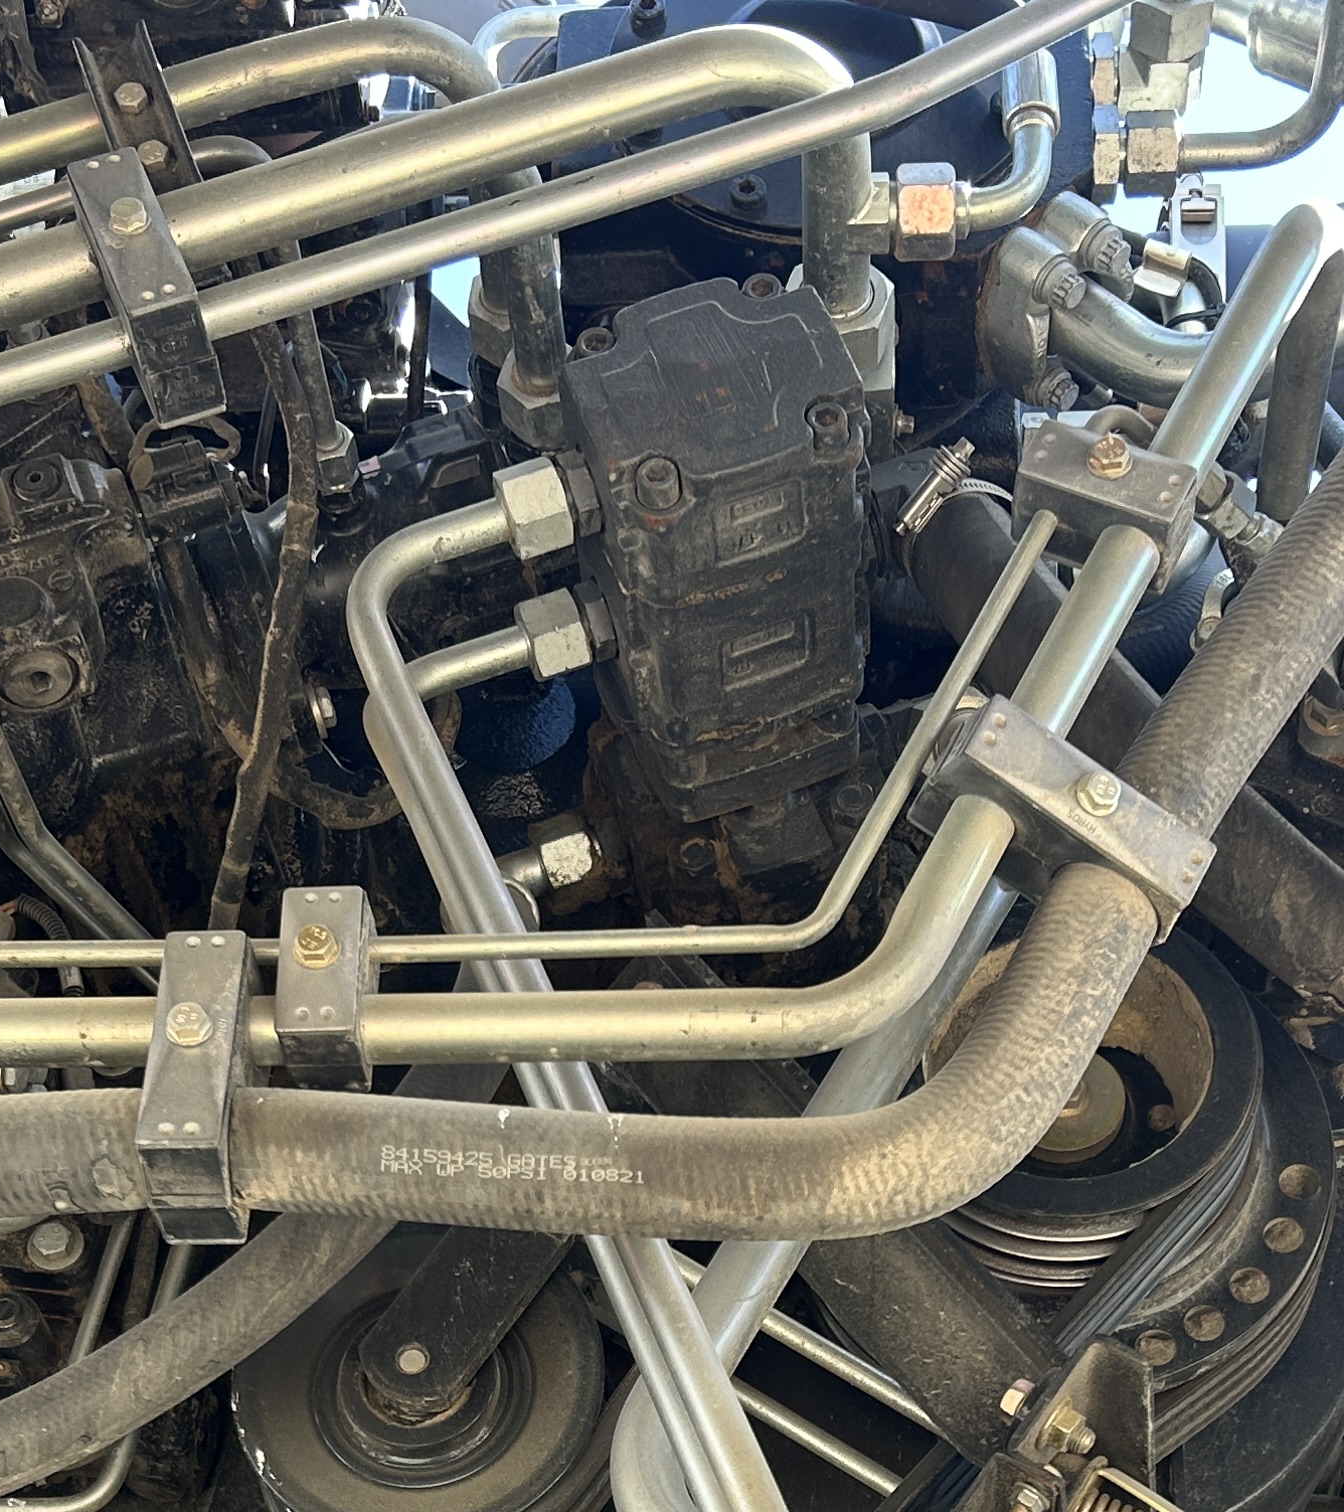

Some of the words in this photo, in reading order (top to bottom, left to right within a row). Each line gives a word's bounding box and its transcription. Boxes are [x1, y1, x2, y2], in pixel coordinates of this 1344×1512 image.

[380, 1158, 424, 1177] MAX
[381, 1144, 494, 1168] 84159425
[507, 1153, 577, 1170] GATES
